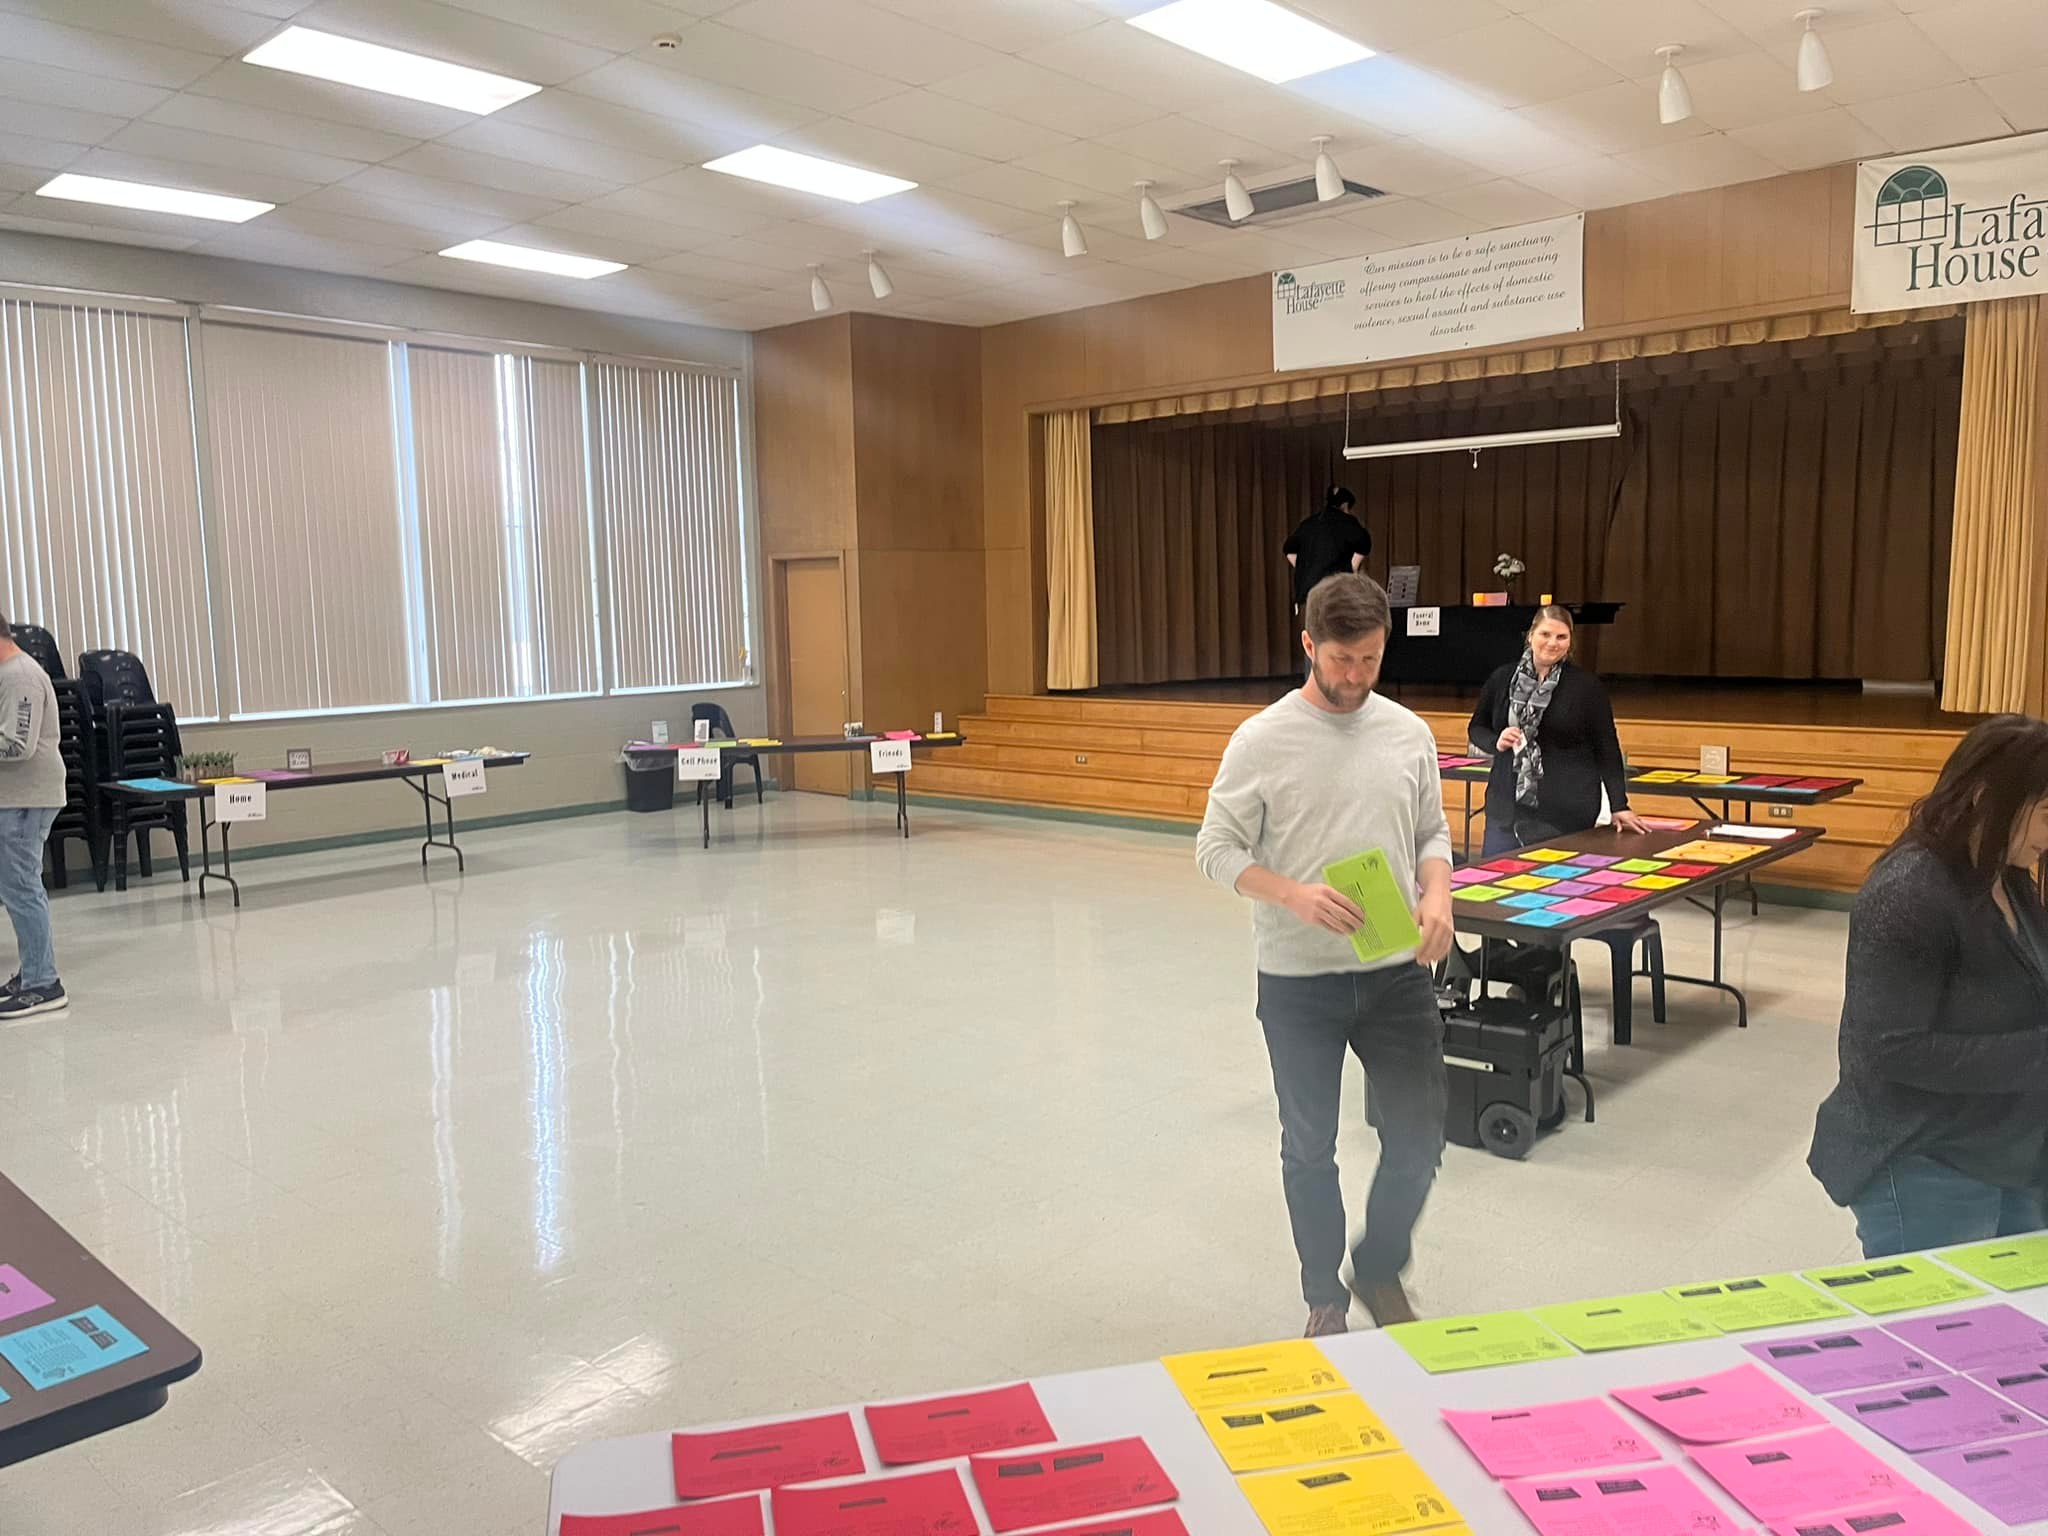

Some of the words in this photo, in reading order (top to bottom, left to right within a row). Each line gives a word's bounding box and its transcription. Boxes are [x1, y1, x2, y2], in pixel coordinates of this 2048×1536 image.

[1950, 193, 2048, 250] Lafa
[1360, 280, 1396, 296] offering
[1399, 268, 1470, 288] compassionate
[1472, 260, 1492, 274] and
[1494, 252, 1559, 272] empowering
[1364, 262, 1385, 274] Our
[1388, 257, 1425, 271] mission
[1428, 254, 1436, 264] is
[1440, 253, 1449, 262] to
[1452, 246, 1462, 260] be
[1465, 249, 1472, 257] a
[1475, 240, 1496, 257] safe
[1906, 242, 2040, 291] House
[1287, 296, 1319, 315] House
[1296, 280, 1346, 303] Lafayette
[1365, 299, 1400, 311] services
[1403, 296, 1413, 304] to
[1415, 288, 1438, 303] heal
[1440, 286, 1453, 298] the
[1457, 281, 1490, 299] effects
[1492, 276, 1504, 292] of
[1506, 272, 1553, 288] domestic
[1354, 316, 1395, 330] violence,
[1398, 307, 1430, 324] sexual
[1432, 302, 1468, 318] assault
[1470, 298, 1489, 312] and
[1492, 294, 1544, 309] substance
[1547, 291, 1566, 300] use
[451, 768, 478, 780] Medical
[681, 757, 695, 766] Cell
[697, 757, 717, 766] Phone
[229, 794, 251, 804] Home
